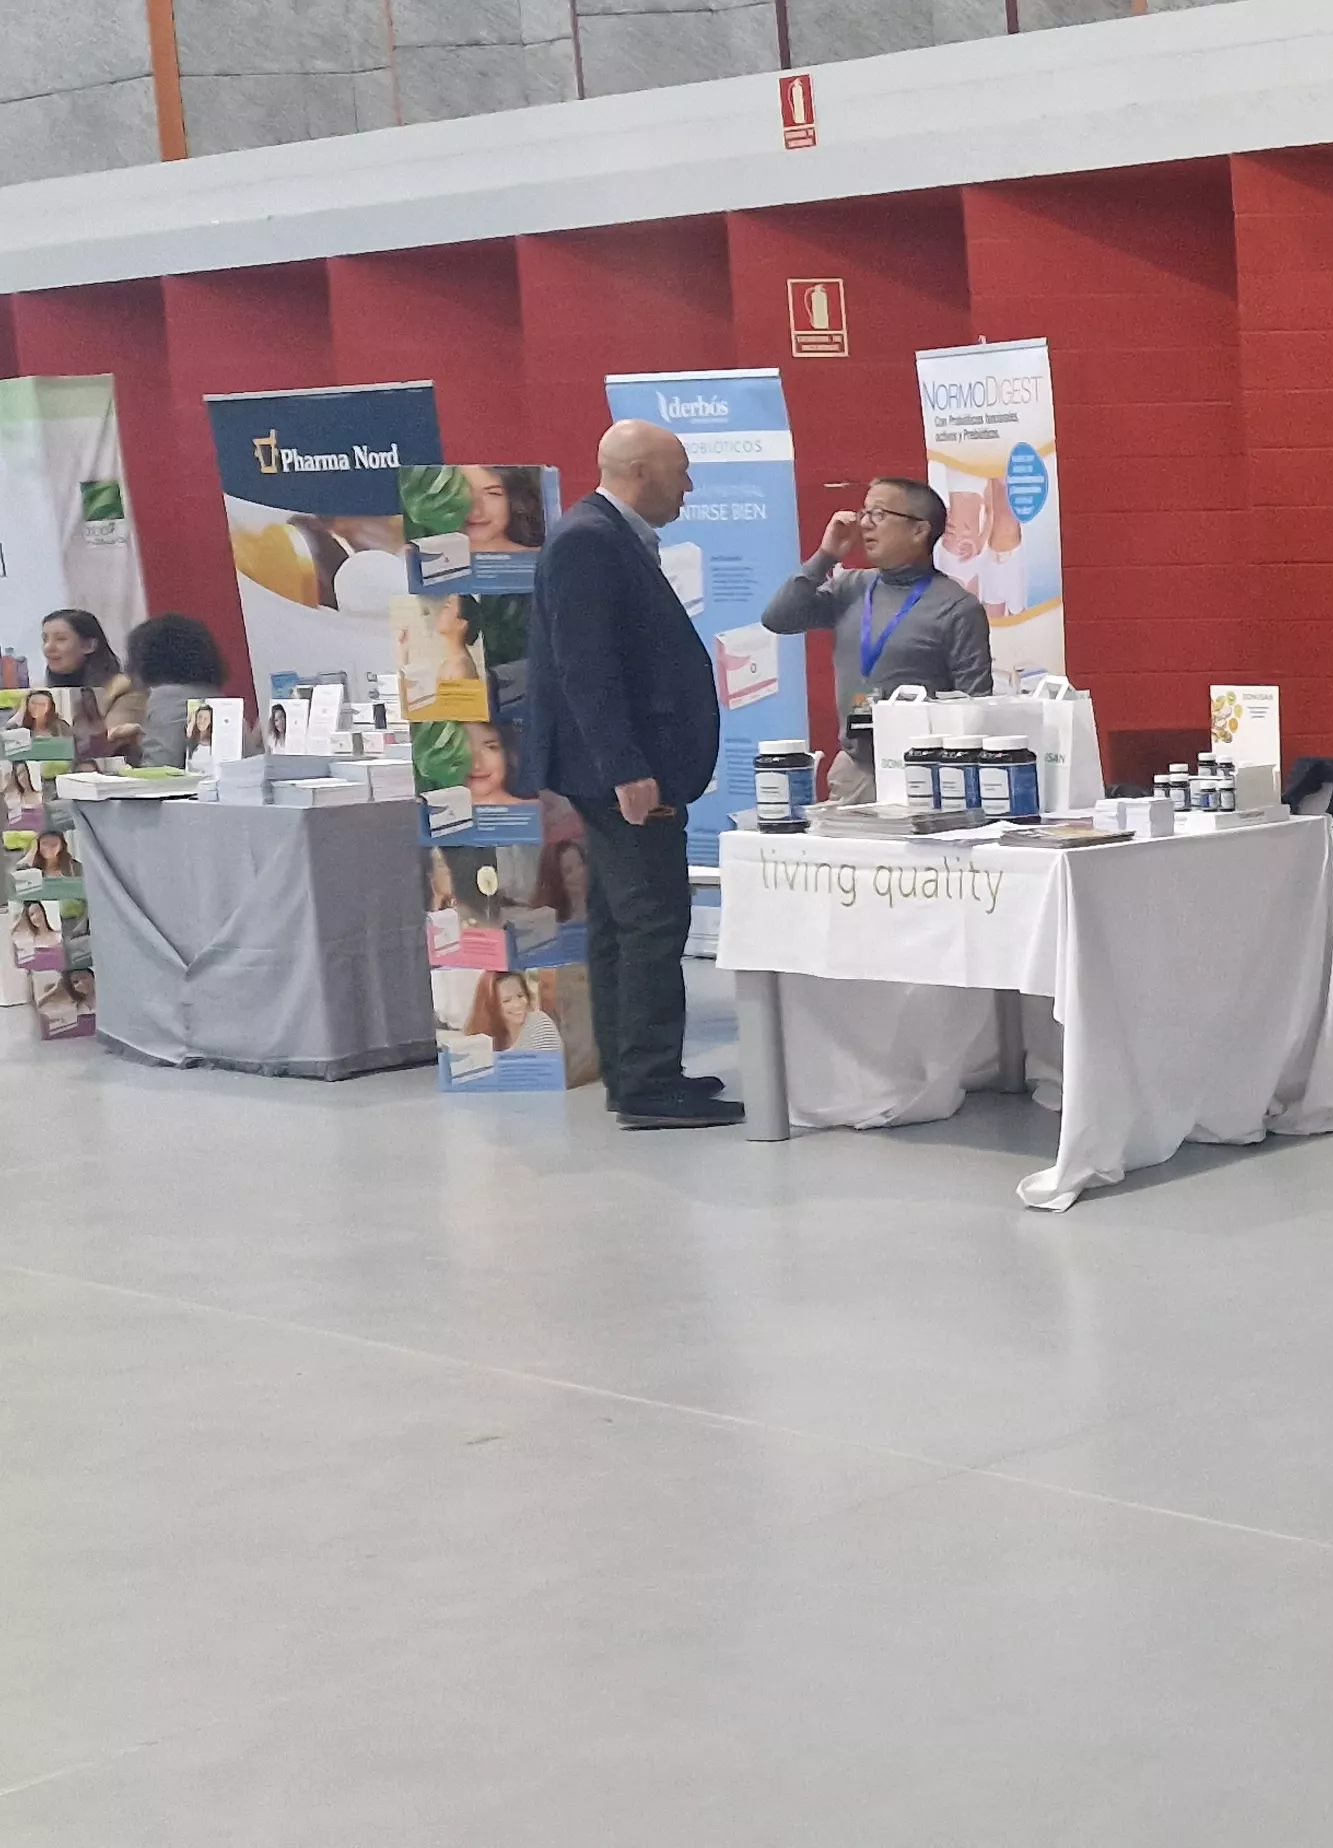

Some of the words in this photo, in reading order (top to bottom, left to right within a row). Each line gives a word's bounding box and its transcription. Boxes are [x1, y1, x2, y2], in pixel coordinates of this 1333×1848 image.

[280, 448, 350, 473] Pharma
[352, 443, 400, 470] Nord
[680, 504, 729, 521] NTIRSE
[731, 503, 767, 521] BIEN
[760, 848, 856, 907] living
[874, 855, 1003, 915] quality
